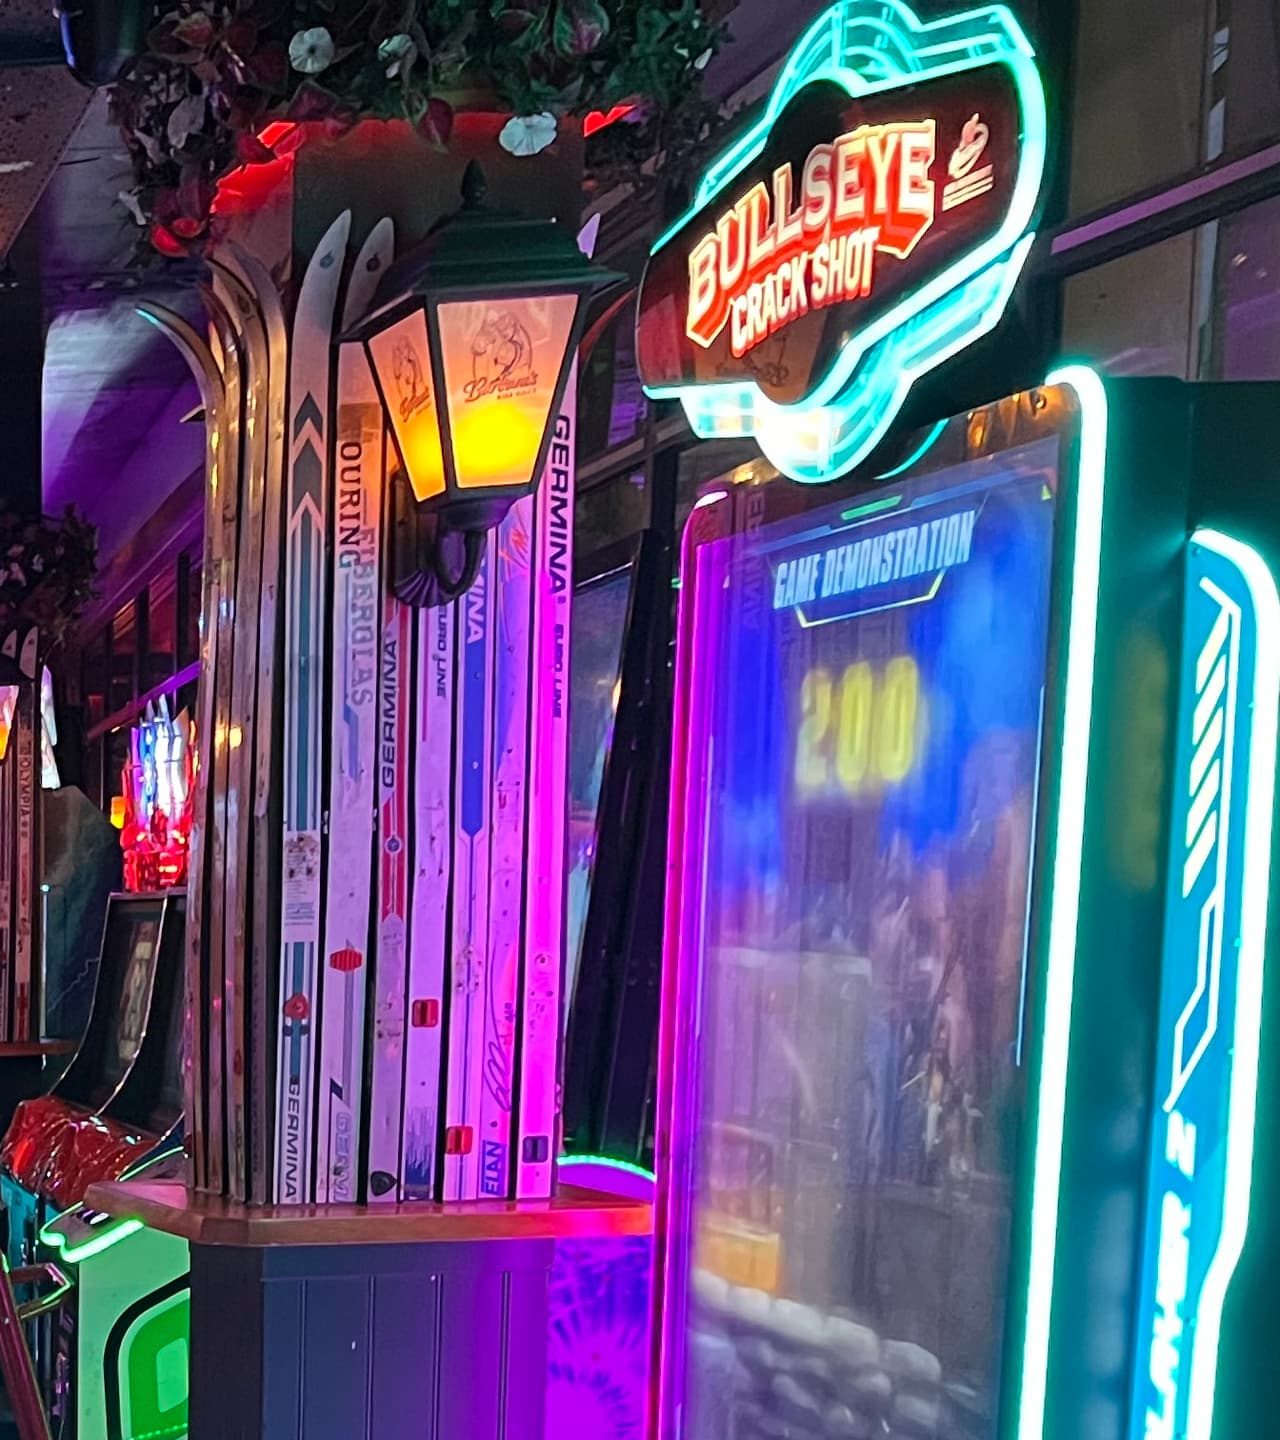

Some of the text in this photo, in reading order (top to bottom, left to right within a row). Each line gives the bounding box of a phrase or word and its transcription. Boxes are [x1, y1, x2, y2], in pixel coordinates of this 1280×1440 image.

[688, 122, 936, 332] BULLSEYE
[732, 227, 880, 356] CRACK SHOT
[339, 440, 361, 570] OURING
[549, 414, 570, 597] GERMINA
[774, 510, 976, 610] GAME DEMONSTRATION
[381, 639, 398, 788] GERMINA
[436, 657, 447, 699] LINE
[552, 624, 564, 719] EURO LINE
[795, 655, 920, 788] 200
[285, 1083, 300, 1198] GERMINA
[483, 1140, 503, 1196] ELAN
